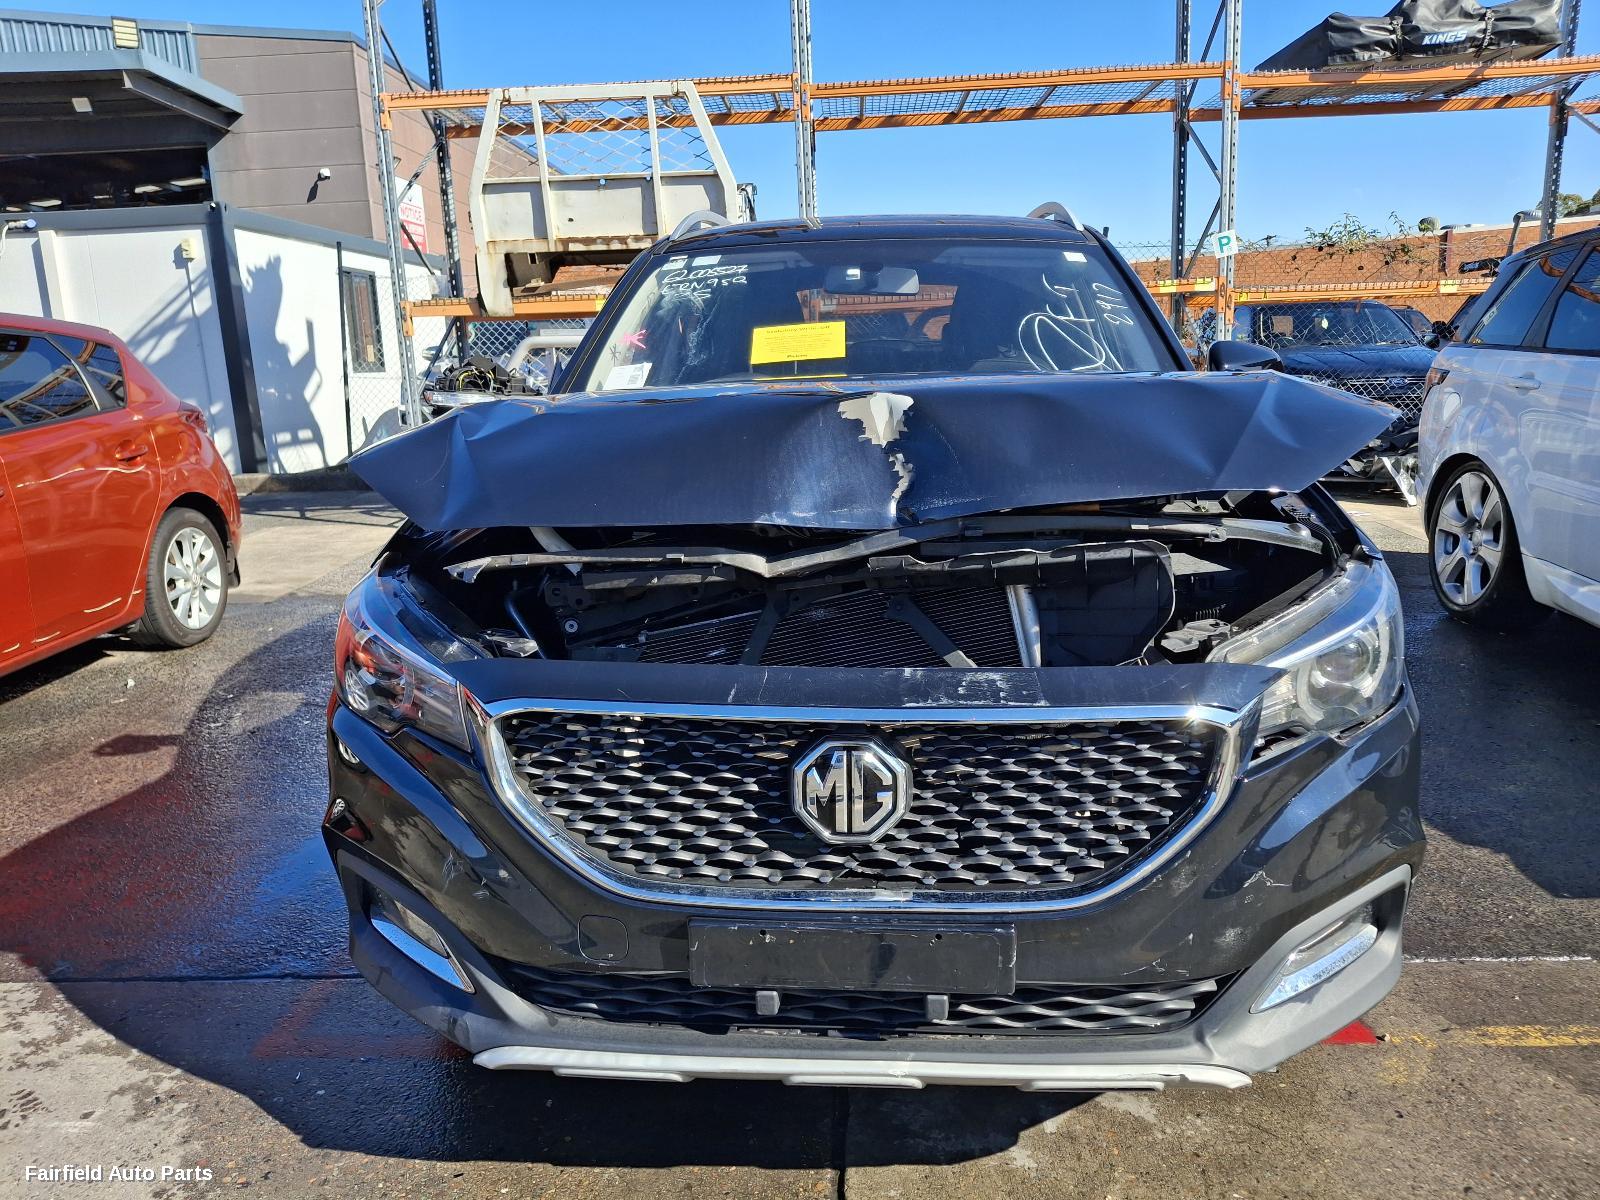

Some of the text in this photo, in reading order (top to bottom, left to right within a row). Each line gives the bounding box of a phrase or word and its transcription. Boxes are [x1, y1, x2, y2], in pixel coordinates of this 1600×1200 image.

[1421, 31, 1468, 46] KINGS
[1217, 235, 1231, 254] P
[806, 750, 893, 833] MG
